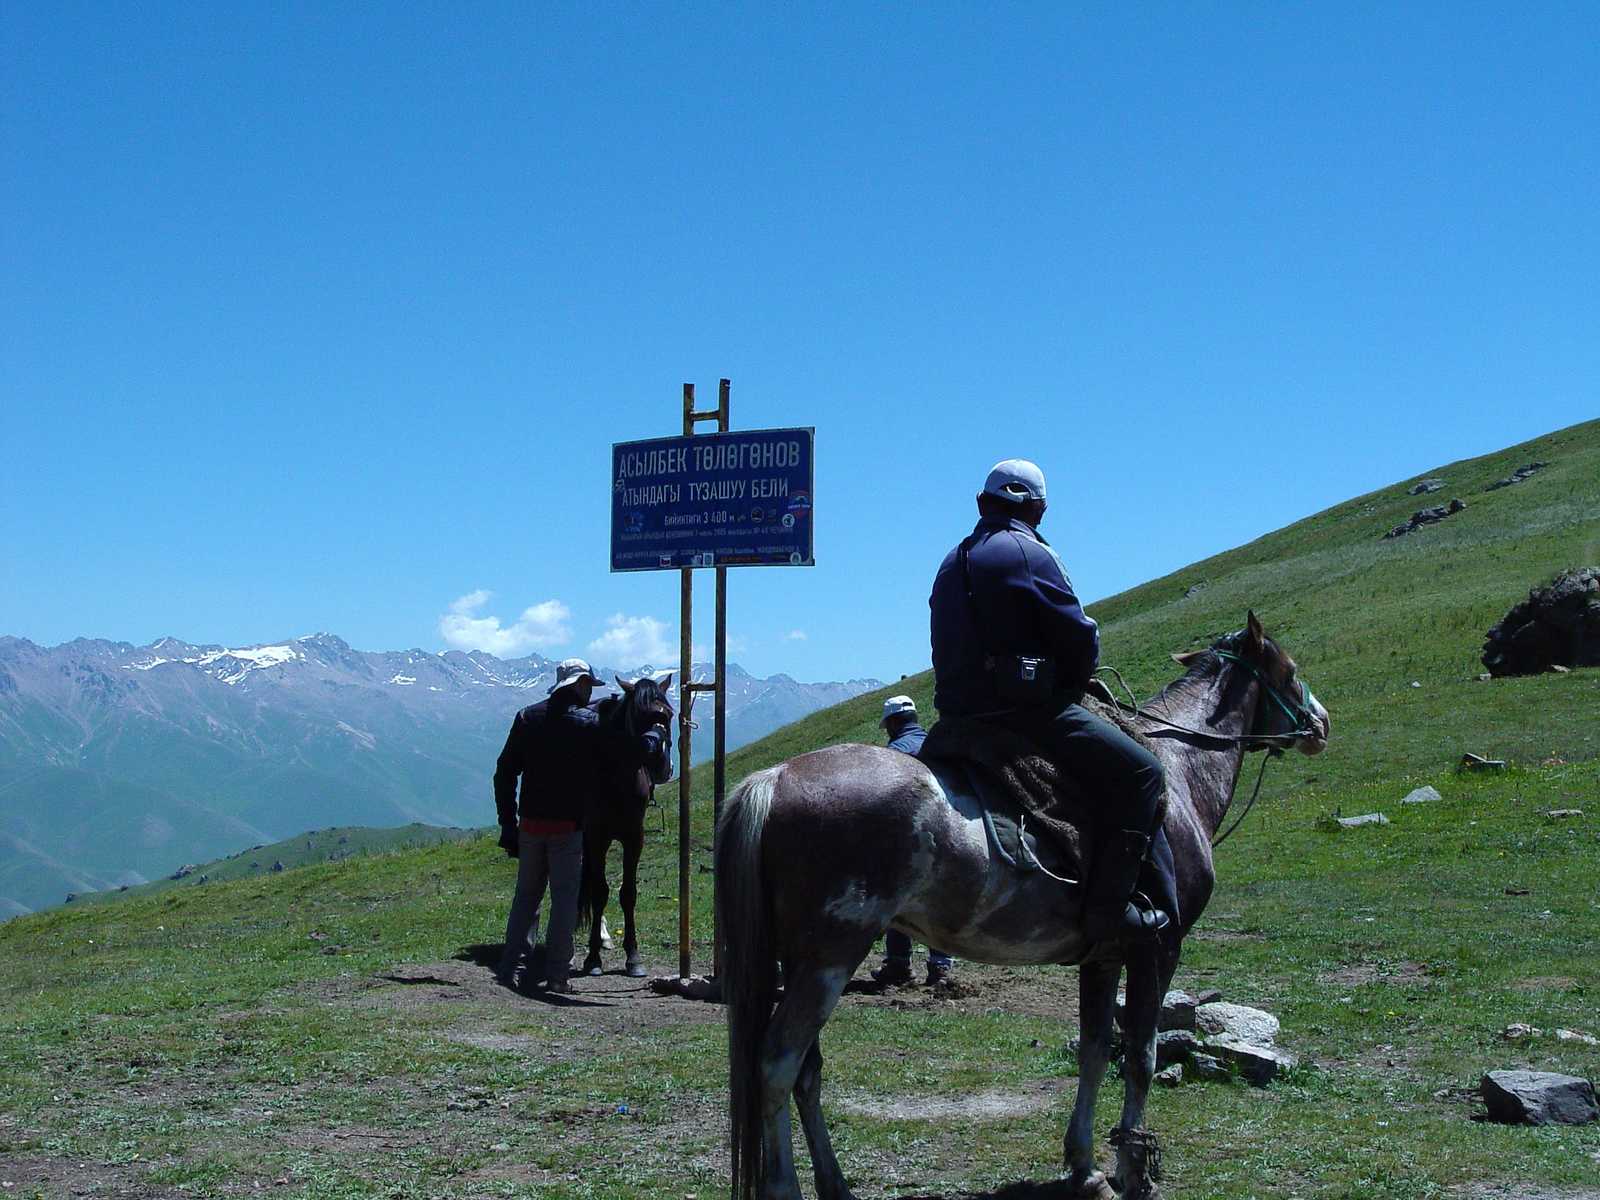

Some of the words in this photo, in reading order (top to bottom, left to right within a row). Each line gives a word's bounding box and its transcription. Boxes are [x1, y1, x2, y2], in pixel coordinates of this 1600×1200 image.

[618, 448, 687, 479] АСЫЛБЕК
[693, 441, 800, 471] ТӨЛӨГӨНОВ
[622, 484, 681, 507] АТЫНДАГЫ
[688, 479, 746, 502] ТҮЗАШУУ
[751, 478, 789, 498] БЕЛИ
